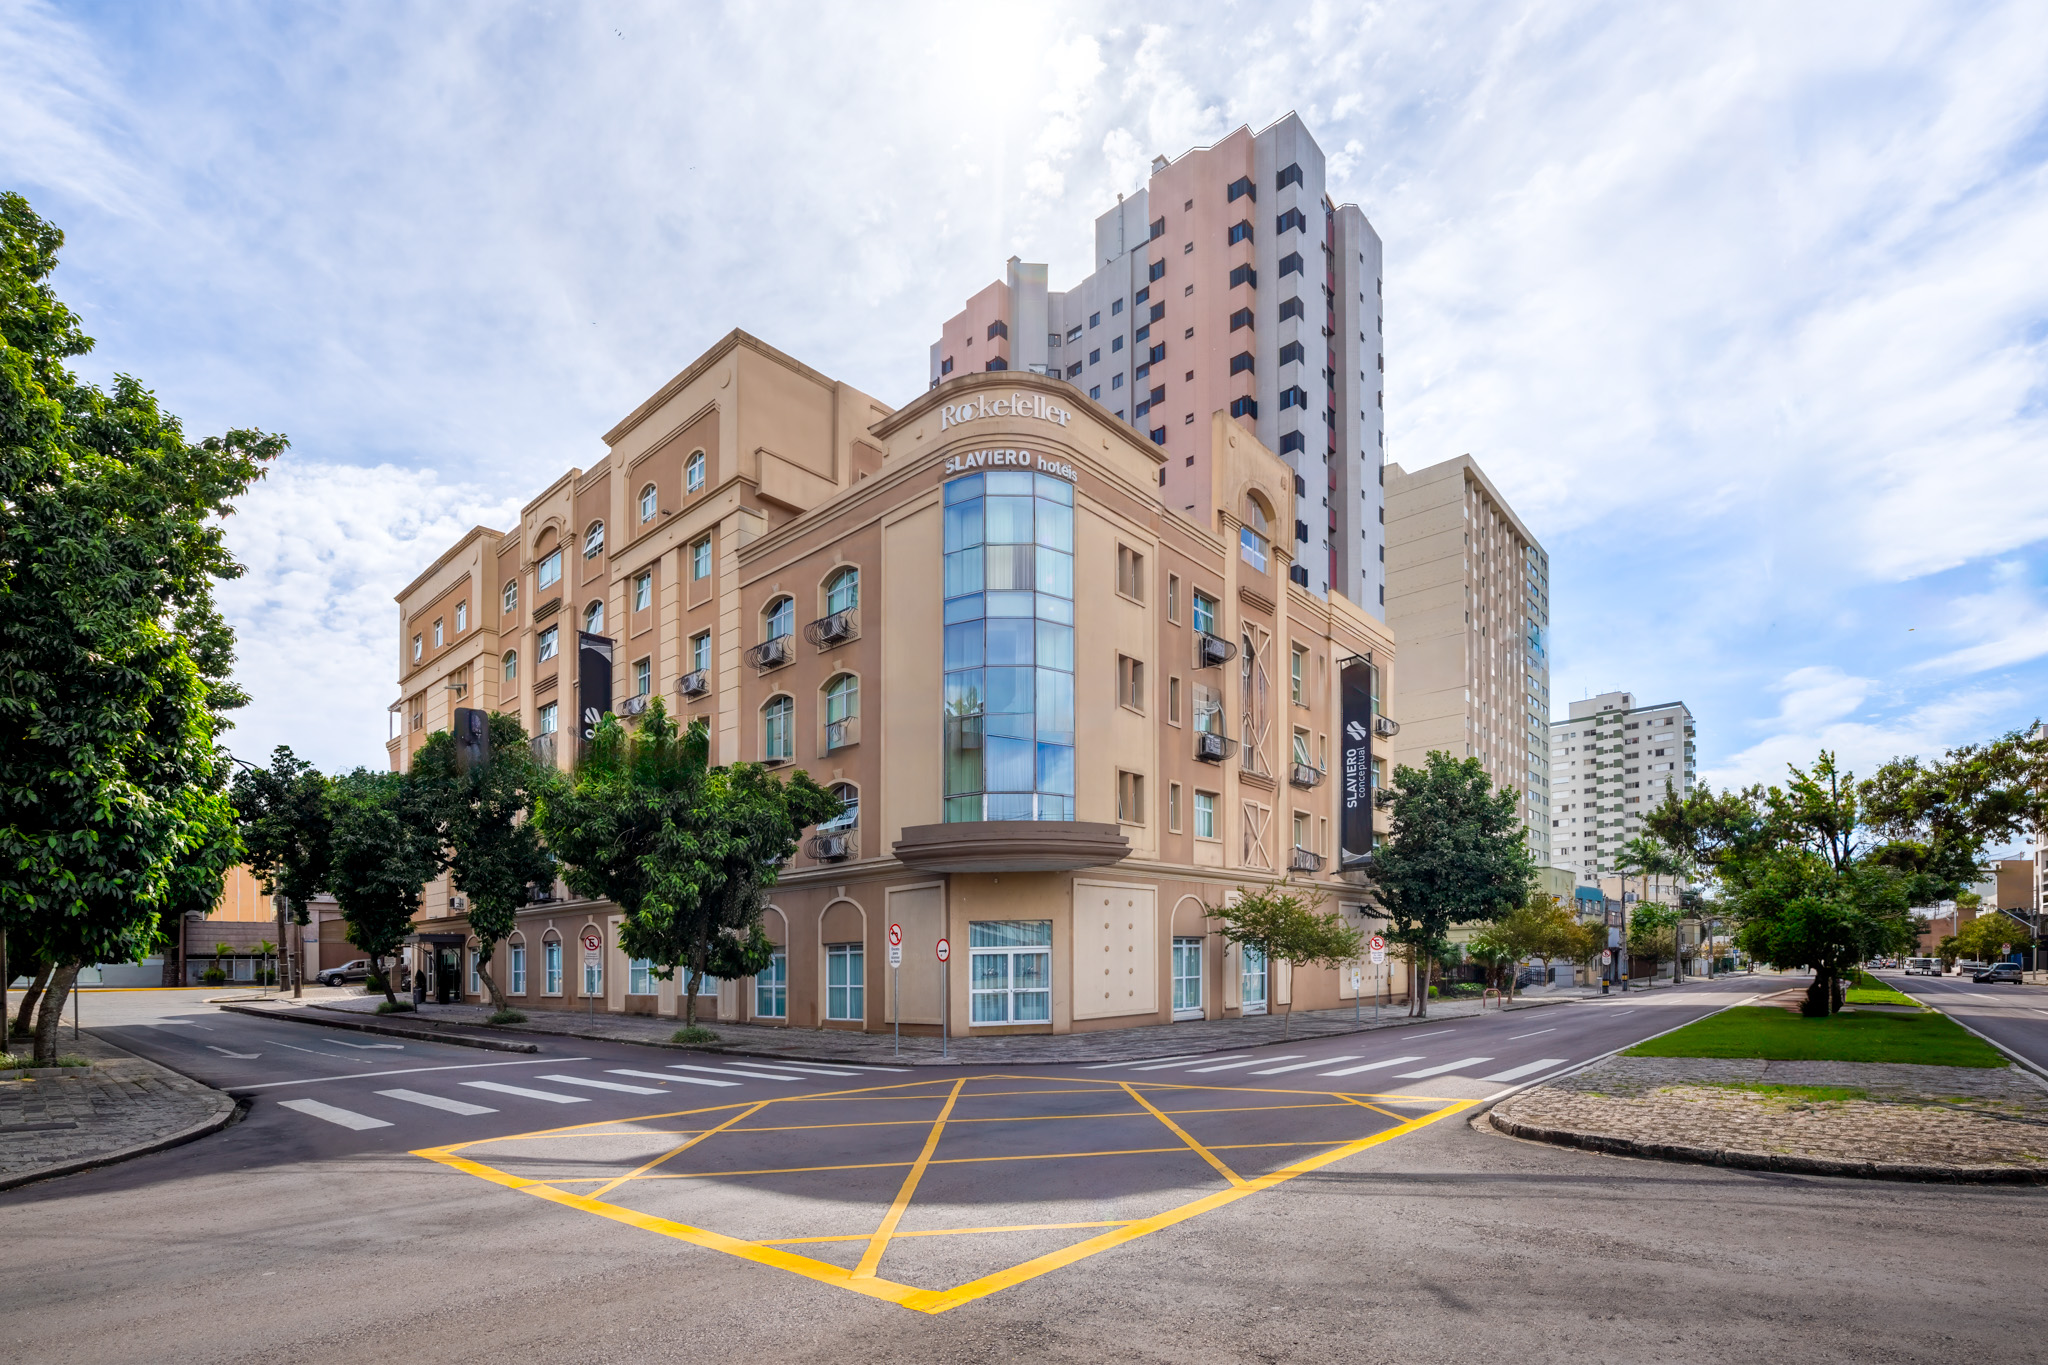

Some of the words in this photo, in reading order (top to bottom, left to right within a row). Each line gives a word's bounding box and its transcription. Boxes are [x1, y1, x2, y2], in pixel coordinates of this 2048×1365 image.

[941, 392, 1071, 432] Rockefeller
[945, 449, 1030, 475] SLAVIERO
[1346, 748, 1358, 809] SLAVIERO
[1357, 746, 1367, 798] conceptual
